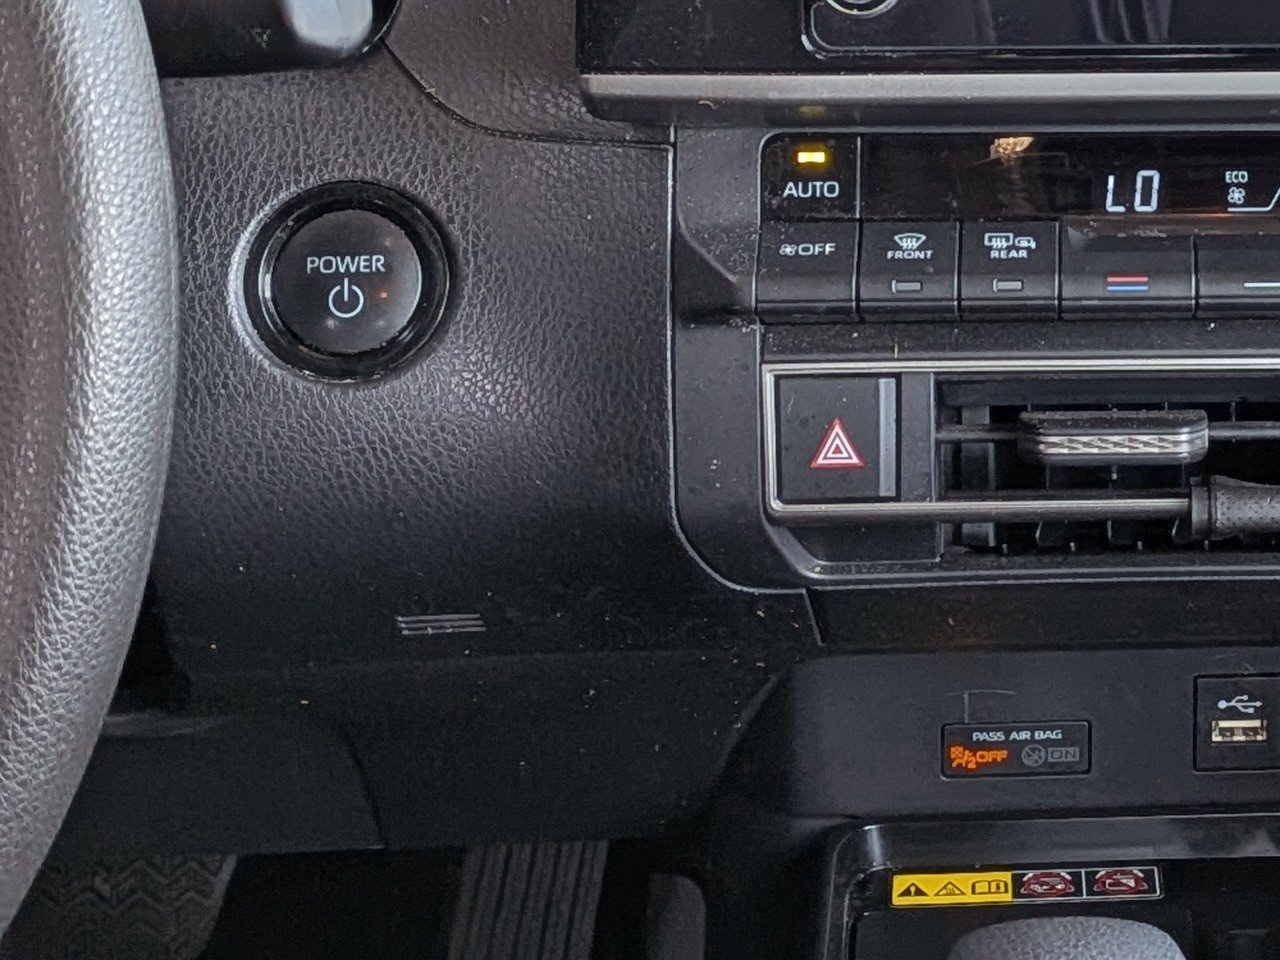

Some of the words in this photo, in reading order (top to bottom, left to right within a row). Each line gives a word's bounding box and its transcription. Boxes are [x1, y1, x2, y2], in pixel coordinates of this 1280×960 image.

[1225, 171, 1248, 183] ECO
[783, 181, 839, 198] AUTO
[798, 243, 835, 256] OFF
[887, 250, 933, 259] FRONT
[990, 249, 1028, 259] REAR
[306, 255, 385, 274] POWER
[973, 731, 1005, 742] PASS
[1009, 730, 1031, 741] AIR
[1034, 730, 1063, 740] BAG
[976, 749, 1008, 763] OFF
[1050, 749, 1077, 761] ON
